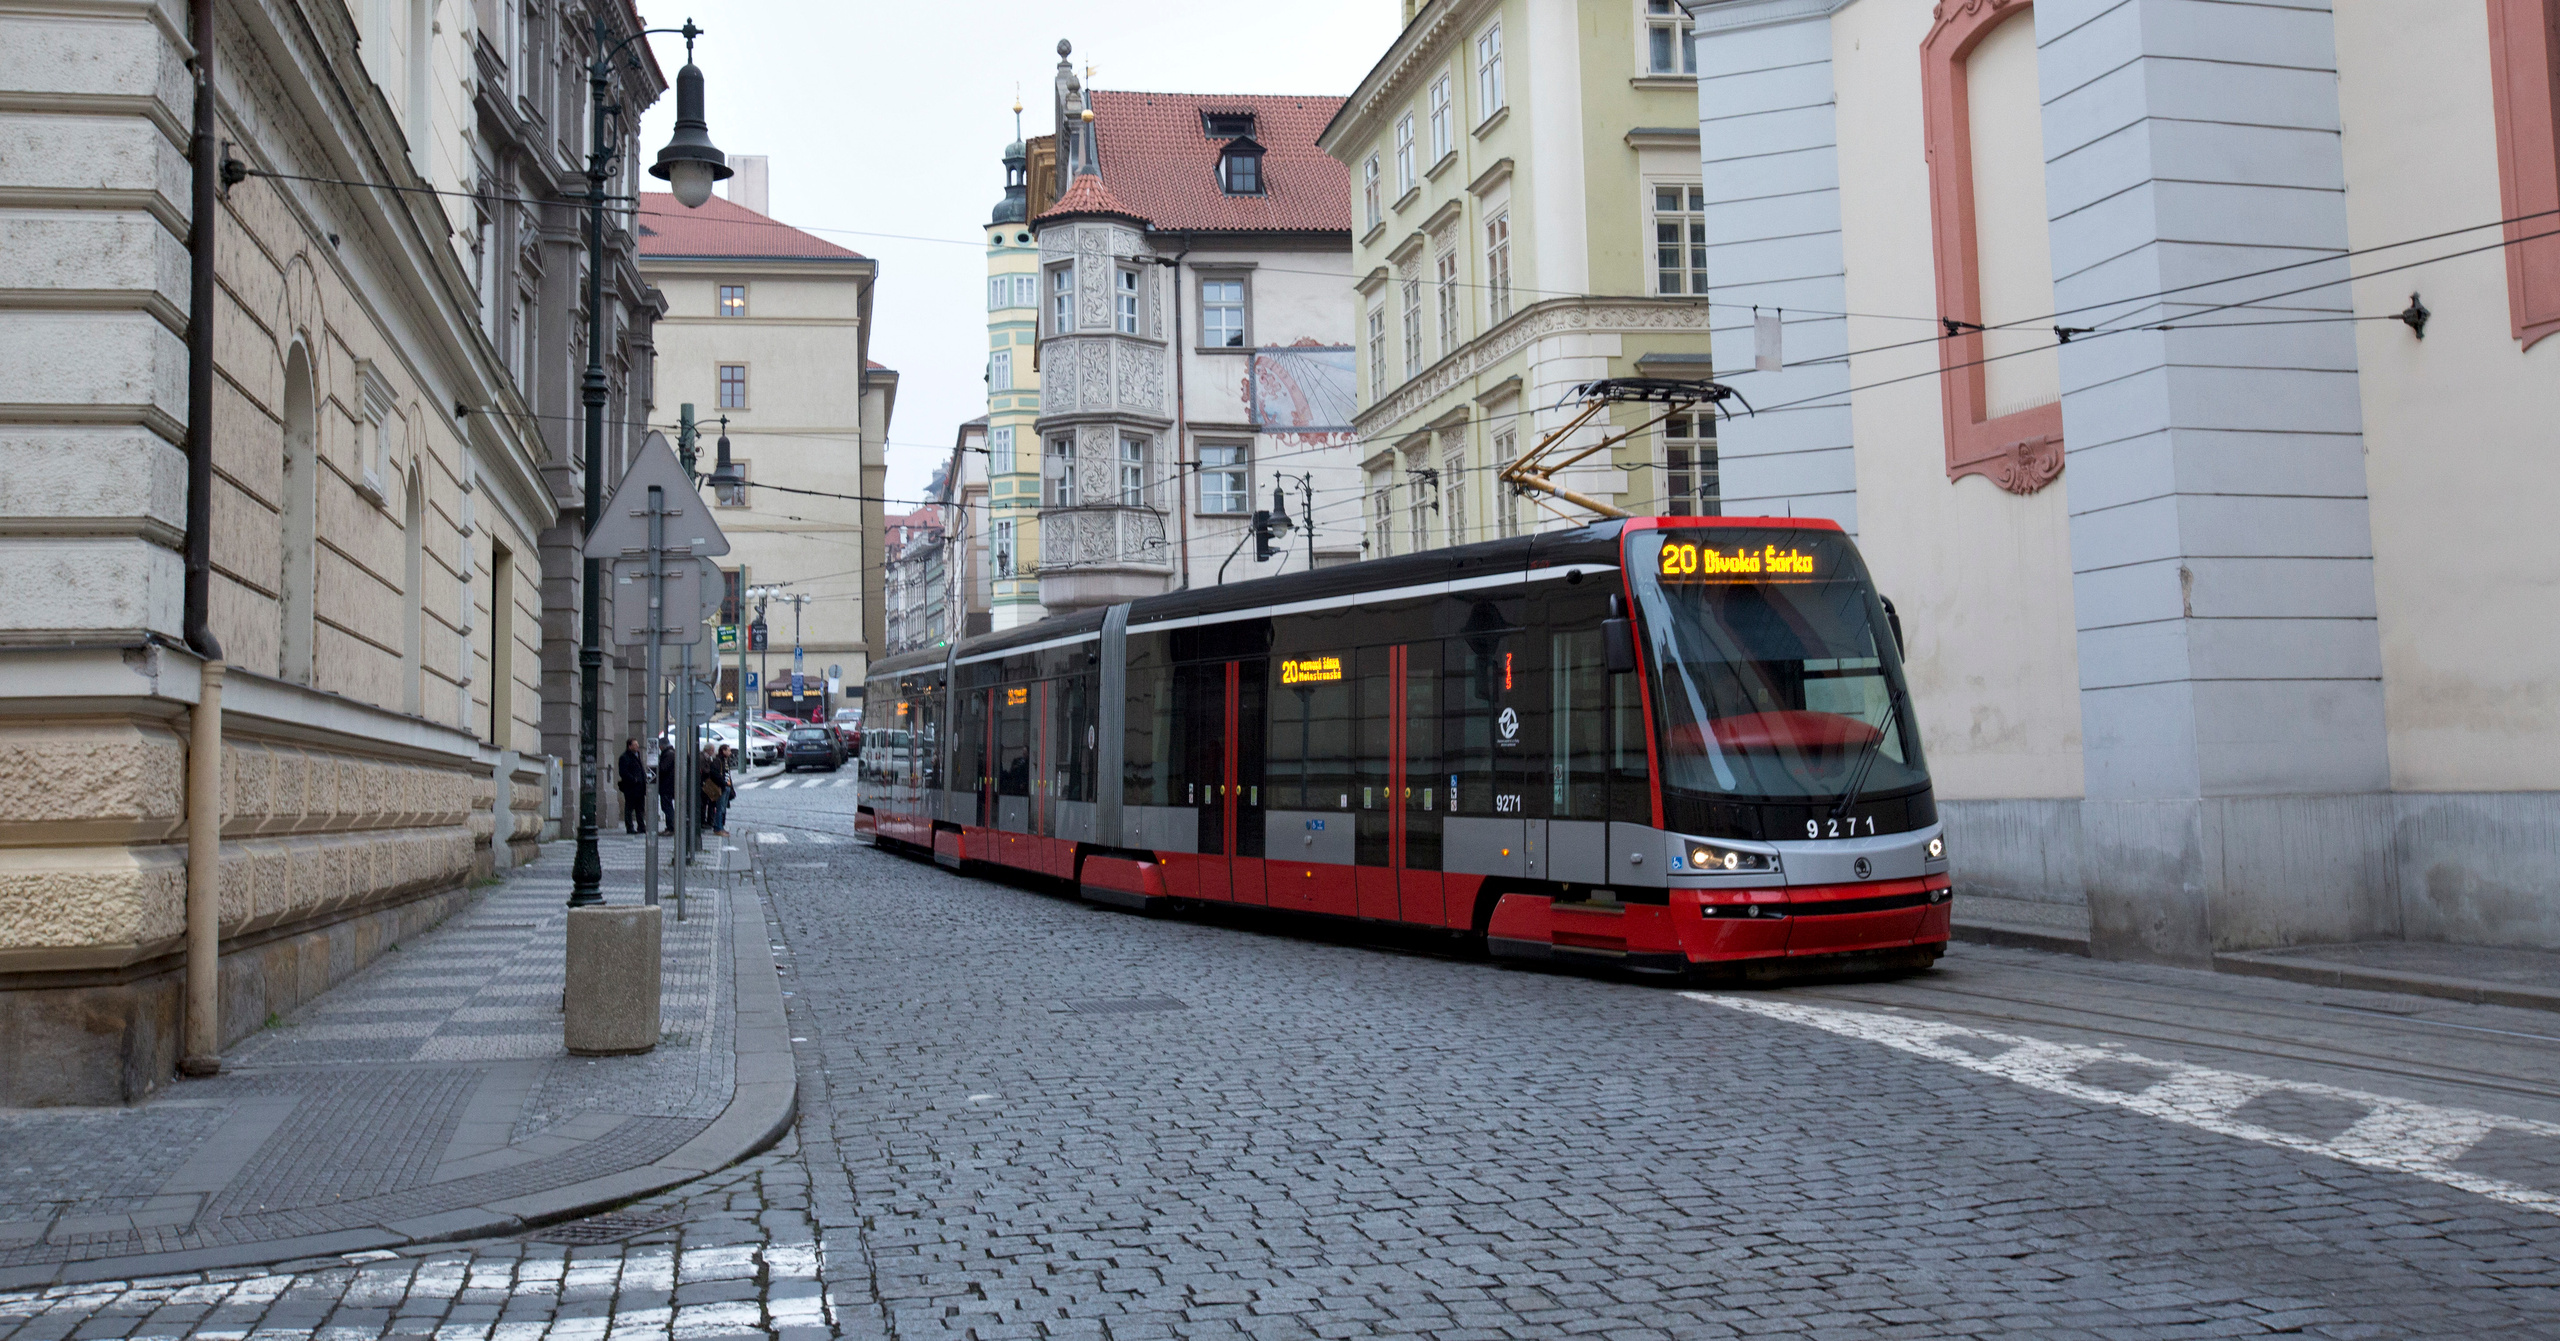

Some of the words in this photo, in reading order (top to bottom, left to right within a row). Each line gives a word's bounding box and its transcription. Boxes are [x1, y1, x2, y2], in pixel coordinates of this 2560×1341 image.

[1662, 544, 1697, 574] 20
[1704, 548, 1760, 574] Divoká
[1765, 544, 1813, 573] Šárka
[747, 673, 755, 685] P
[1282, 660, 1299, 684] 20
[1496, 794, 1521, 812] 9271
[1806, 815, 1875, 839] 9271
